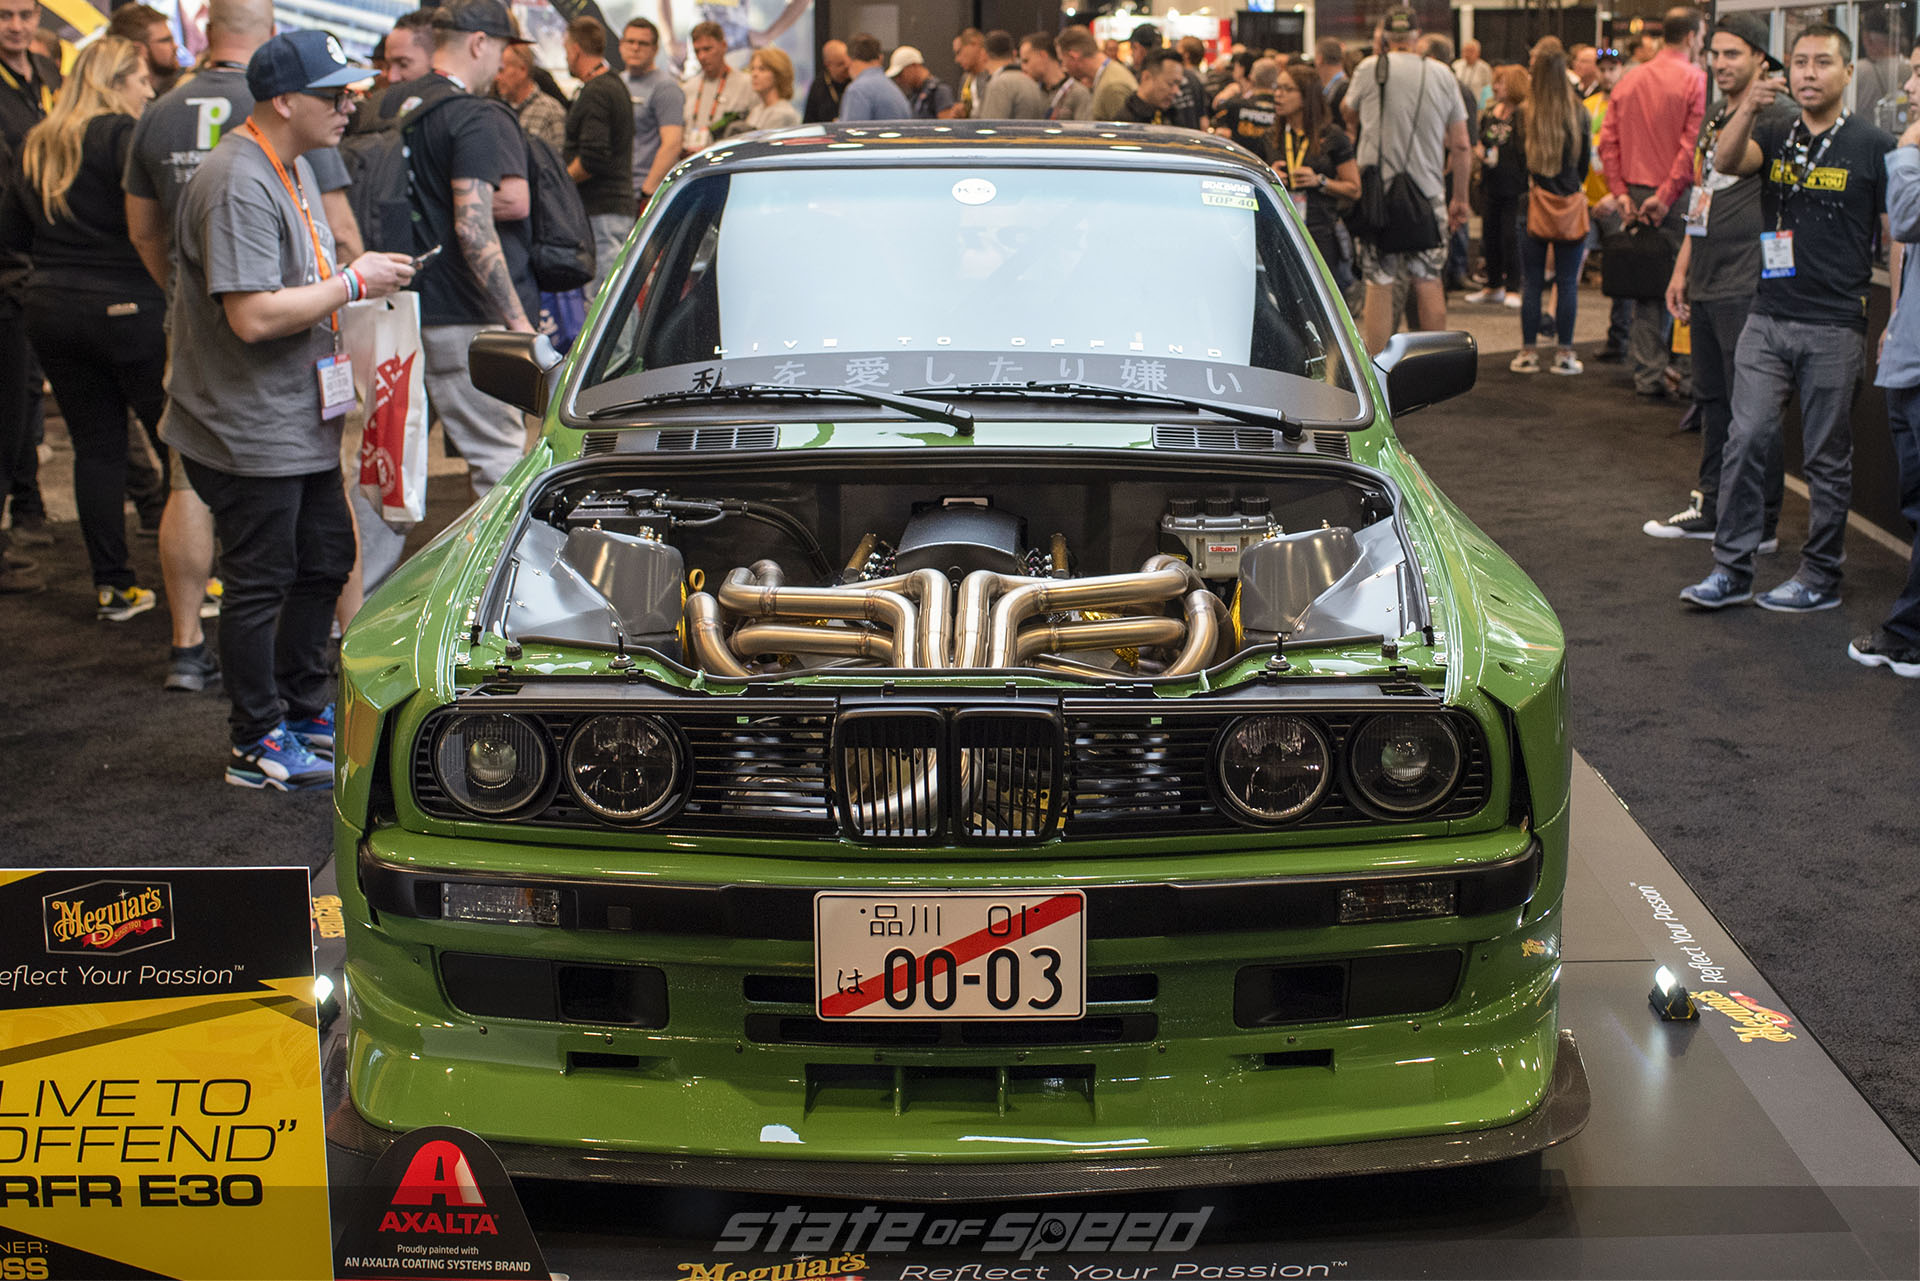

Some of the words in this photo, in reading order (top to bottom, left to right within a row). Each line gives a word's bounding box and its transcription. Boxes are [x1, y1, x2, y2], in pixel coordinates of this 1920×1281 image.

[52, 886, 162, 945] Meguiar's
[870, 904, 941, 937] 品川
[988, 904, 1026, 937] 01
[1665, 922, 1695, 944] Your
[78, 966, 132, 985] Your
[837, 968, 865, 996] は
[884, 948, 1063, 1011] 00-03
[0, 1080, 140, 1117] LIVE
[156, 1079, 252, 1117] TO
[0, 1175, 122, 1207] RFR
[139, 1174, 263, 1207] E30
[378, 1211, 499, 1235] AXALTA
[397, 1244, 427, 1255] Proudly
[429, 1246, 459, 1255] painted
[460, 1246, 479, 1255] with
[344, 1257, 360, 1267] AN
[362, 1258, 400, 1268] AXALTA
[402, 1259, 445, 1269] COATING
[447, 1260, 492, 1270] SYSTEMS
[495, 1261, 531, 1271] BRAND
[899, 1264, 1049, 1281] Reflect
[1067, 1264, 1158, 1280] Your
